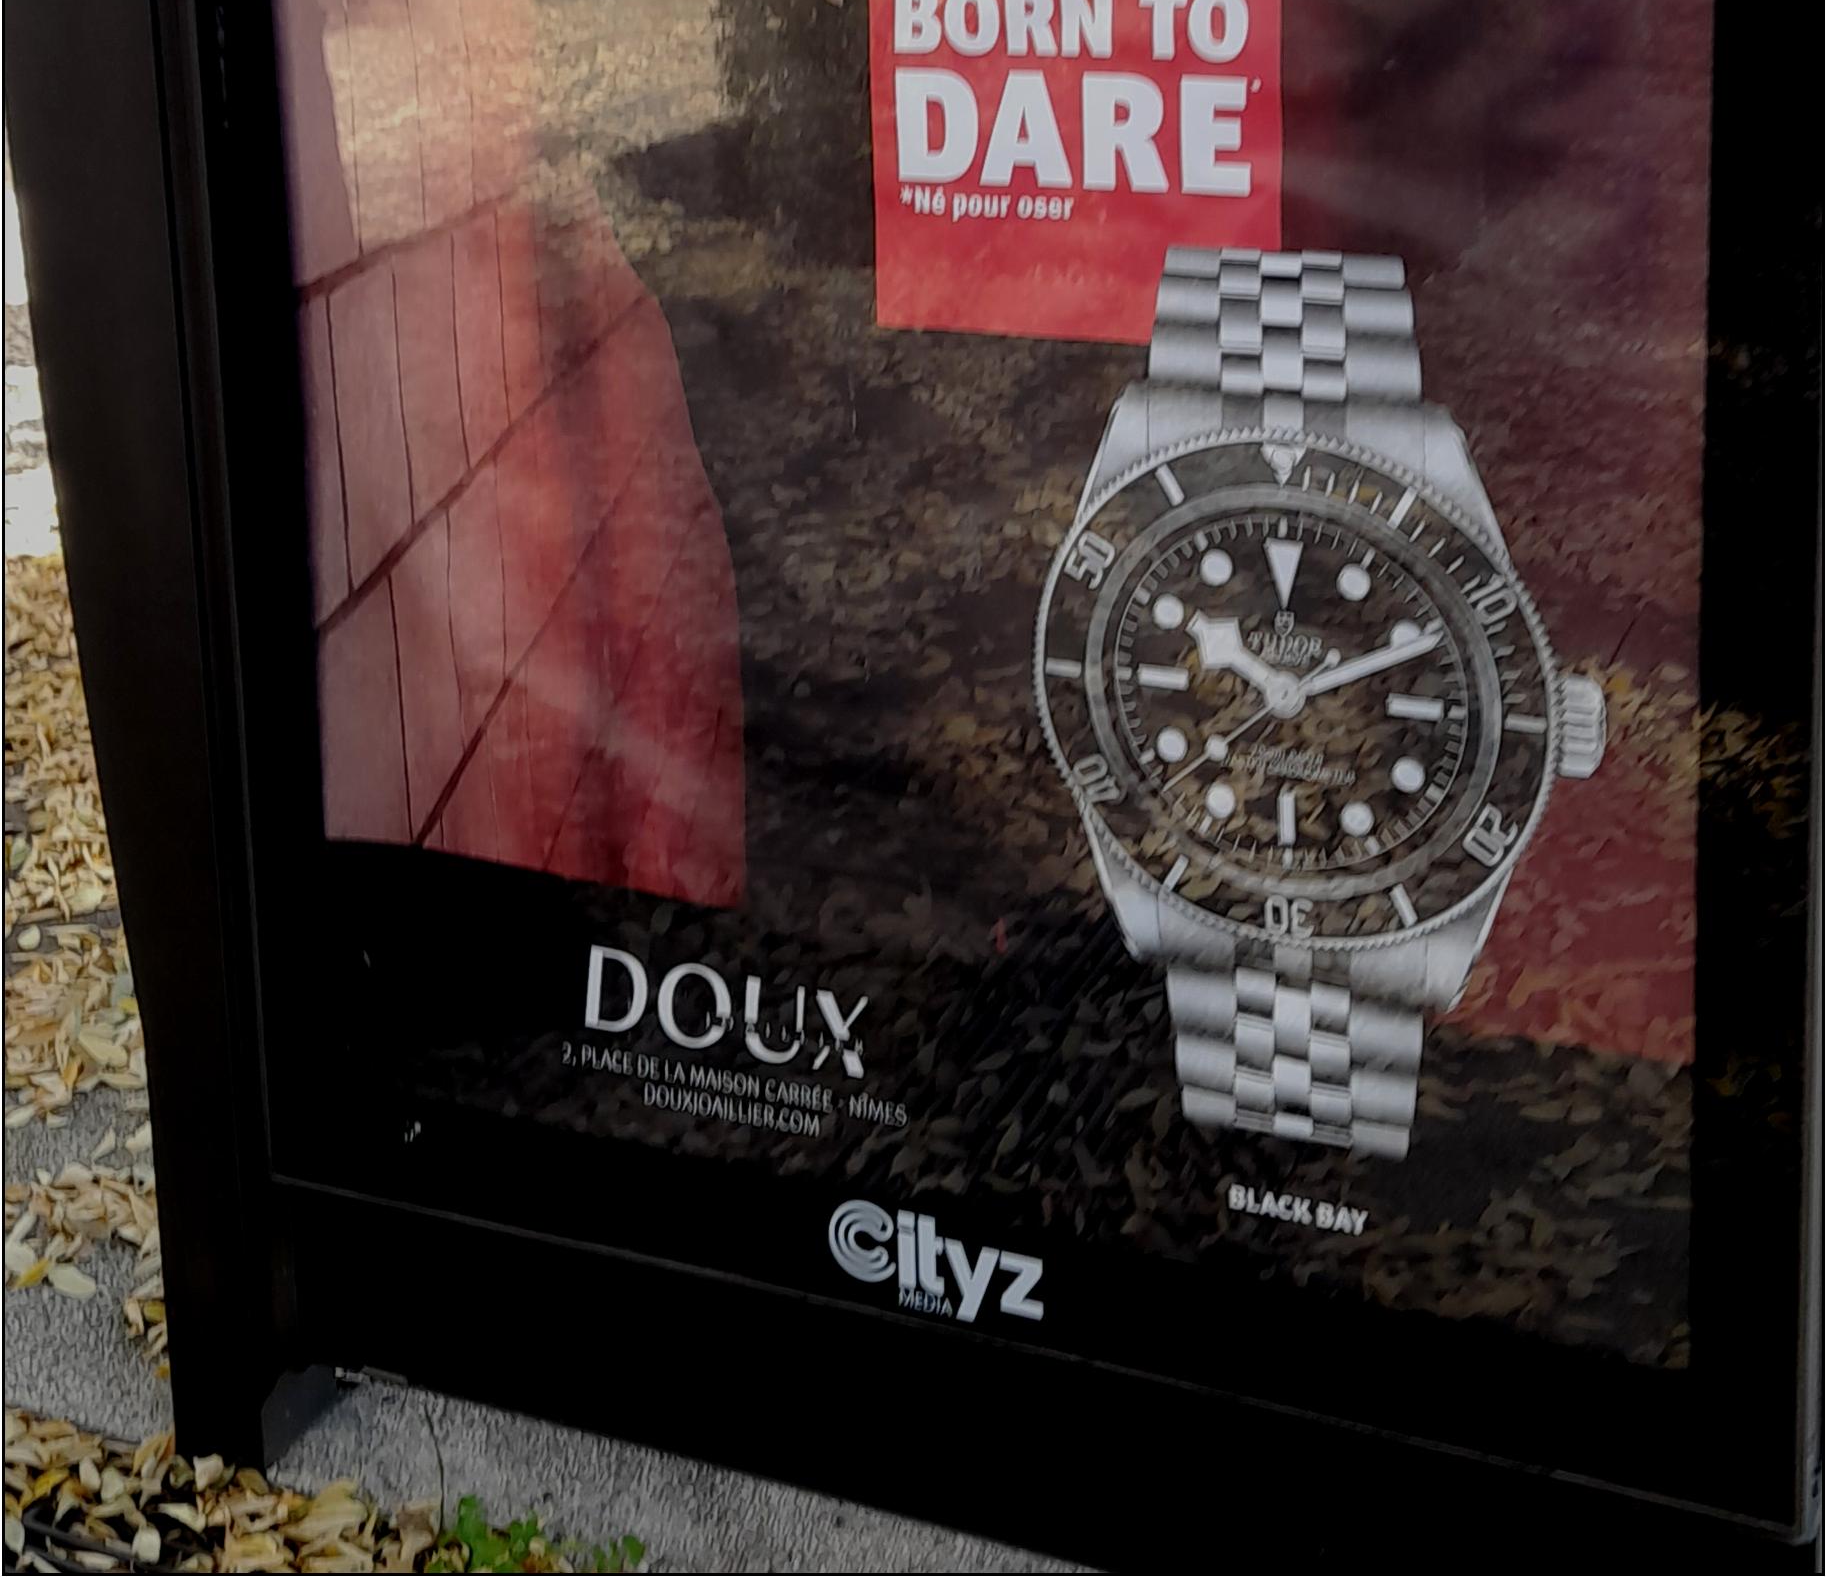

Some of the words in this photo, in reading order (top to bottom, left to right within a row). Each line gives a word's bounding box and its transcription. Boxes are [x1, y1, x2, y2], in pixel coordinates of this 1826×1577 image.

[952, 192, 1009, 222] pour
[1017, 196, 1074, 220] oser
[585, 944, 869, 1079] DOUX
[582, 1045, 633, 1075] PLACE
[637, 1055, 660, 1080] DE
[665, 1059, 686, 1084] LA
[690, 1065, 759, 1097] MAISON
[765, 1081, 833, 1114] CARRÉE
[849, 1092, 908, 1128] NÎMES
[644, 1082, 821, 1138] DOUXJOAILLIER.COM
[1228, 1183, 1313, 1226] BLACK
[1315, 1201, 1369, 1237] BAY
